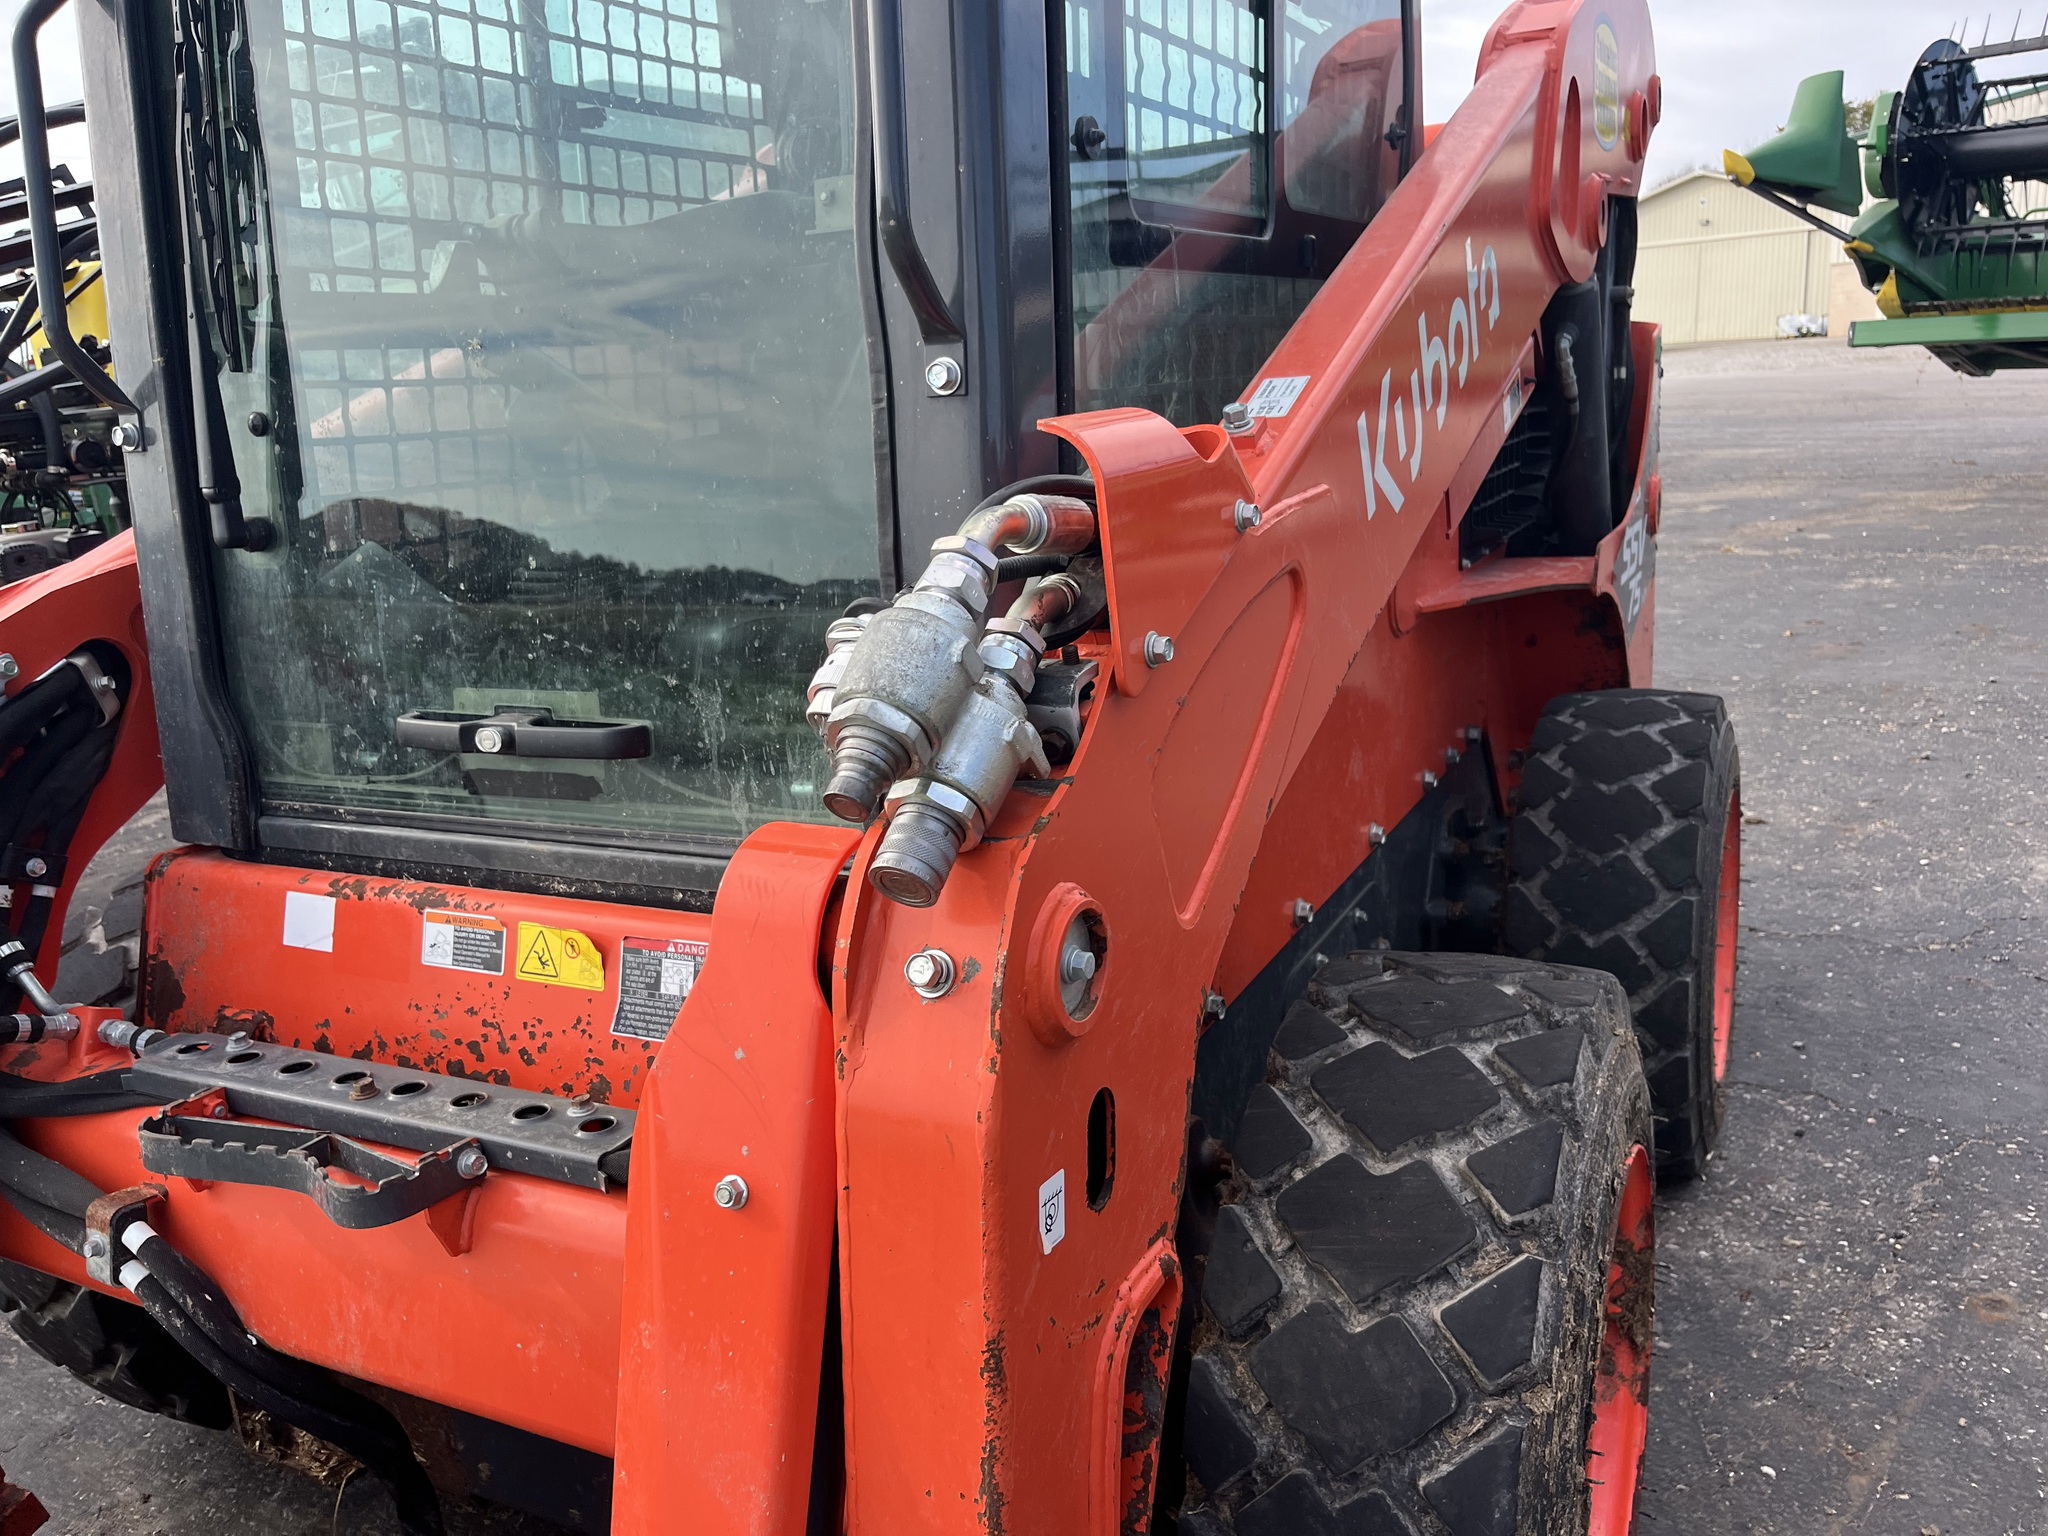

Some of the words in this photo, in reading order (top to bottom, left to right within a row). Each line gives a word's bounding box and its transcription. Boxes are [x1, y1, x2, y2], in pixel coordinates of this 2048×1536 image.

[1357, 236, 1500, 521] Kubota
[1620, 514, 1648, 586] SSV
[1628, 571, 1642, 623] 75
[453, 917, 484, 927] WARNING
[668, 953, 694, 962] PERSONAL
[678, 944, 708, 955] DANG
